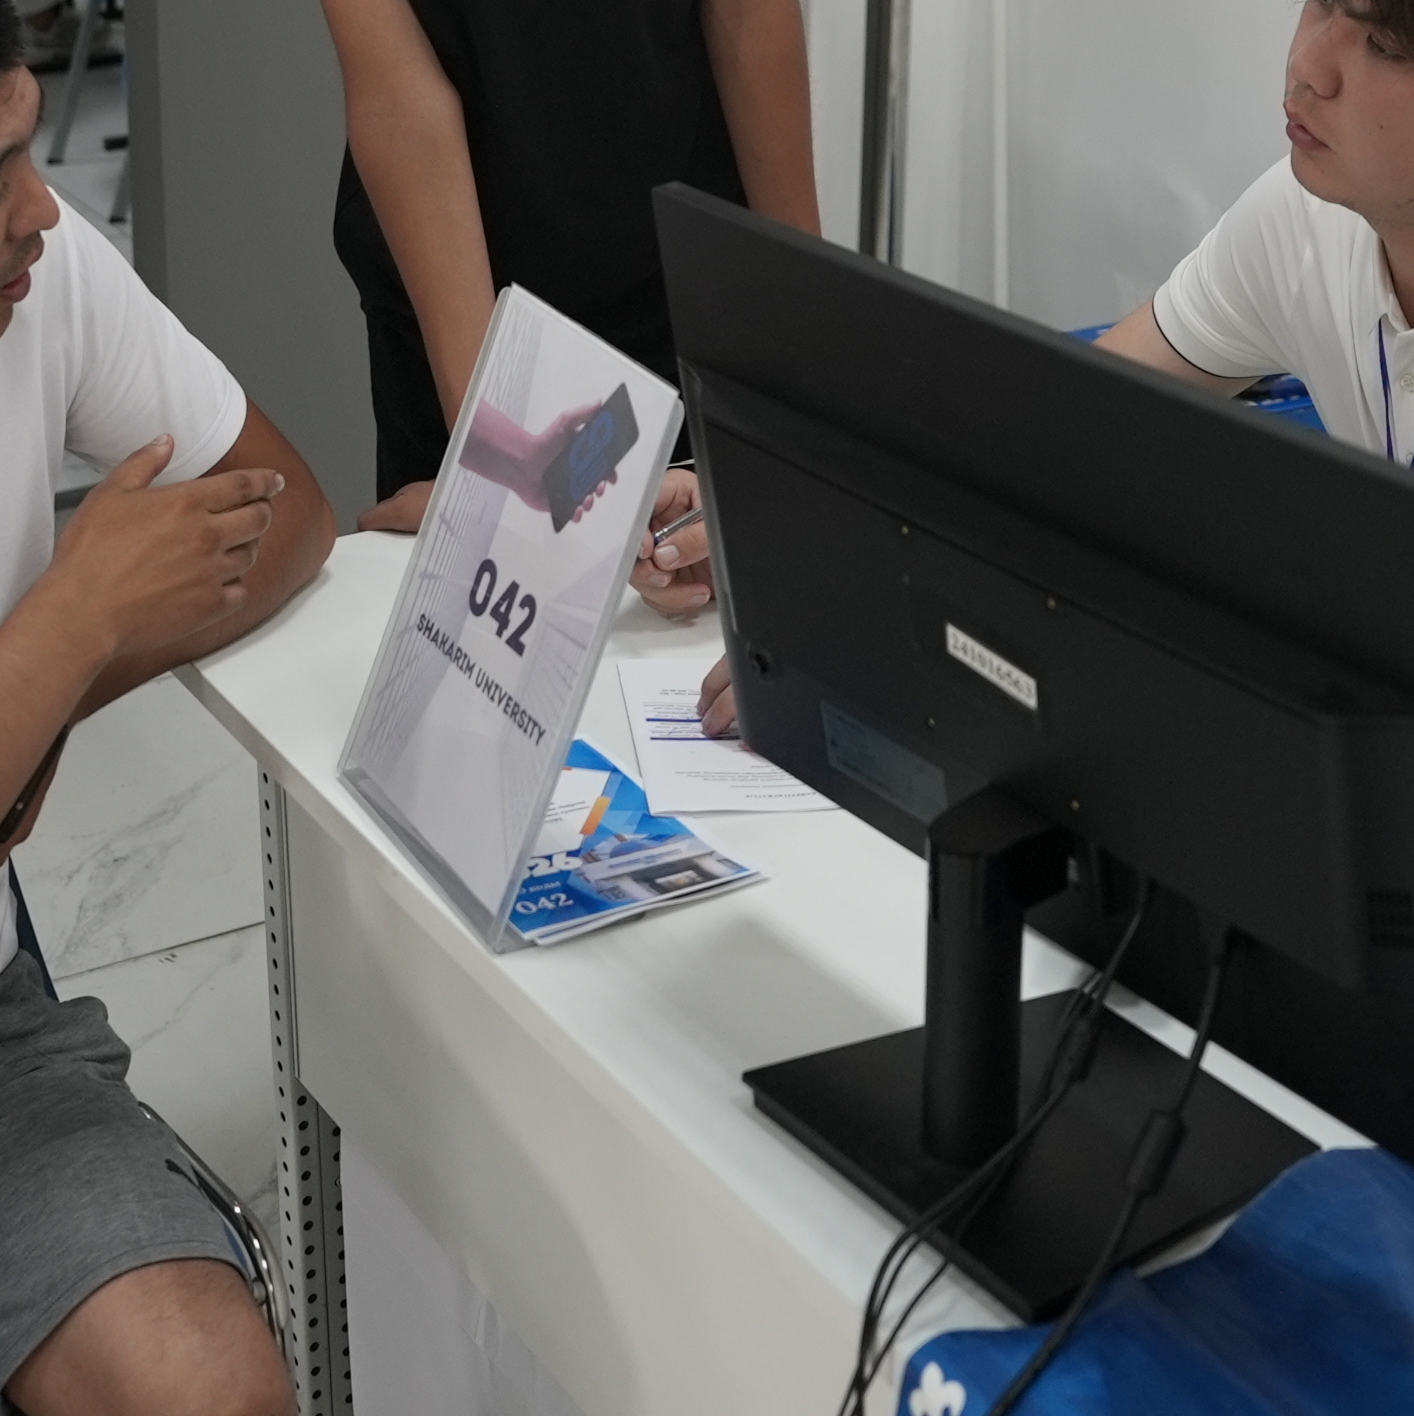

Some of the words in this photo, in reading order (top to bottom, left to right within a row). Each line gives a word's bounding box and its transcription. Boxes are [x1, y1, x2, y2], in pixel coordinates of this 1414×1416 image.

[469, 558, 536, 658] 042
[417, 613, 476, 680] SHAKARIM
[475, 667, 546, 746] UNIVERSITY
[521, 853, 584, 880] 26
[515, 892, 574, 915] 042
